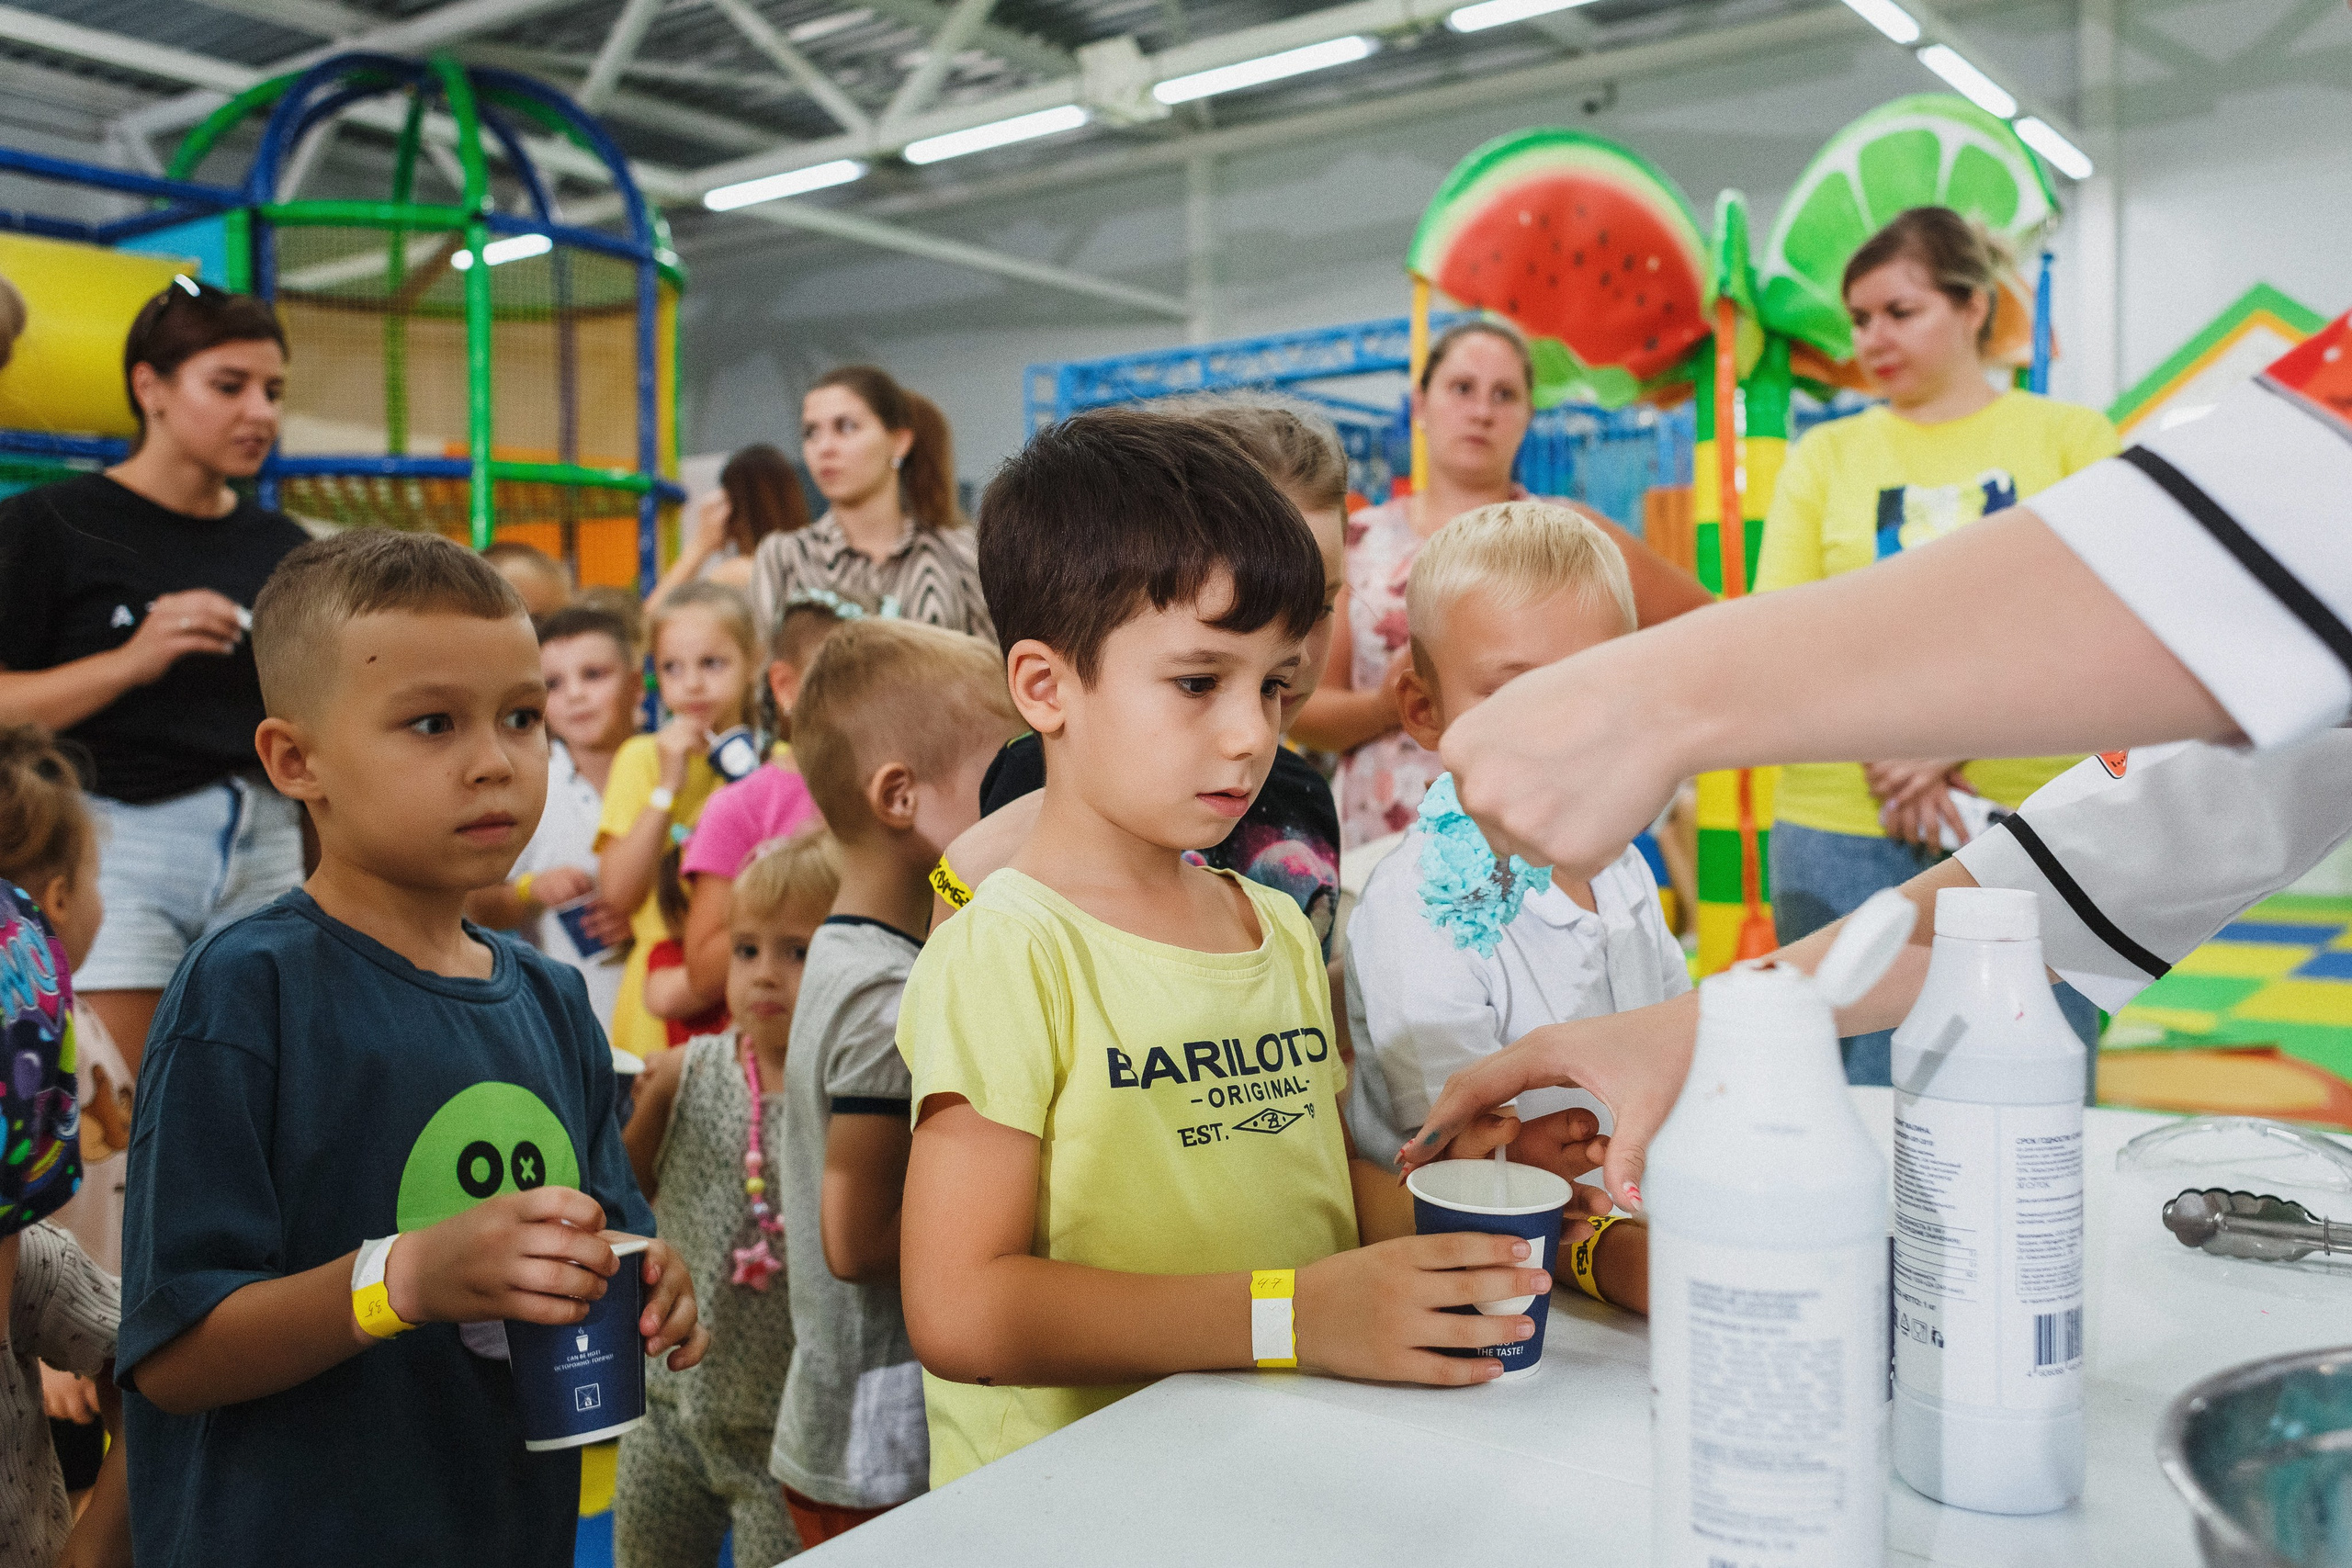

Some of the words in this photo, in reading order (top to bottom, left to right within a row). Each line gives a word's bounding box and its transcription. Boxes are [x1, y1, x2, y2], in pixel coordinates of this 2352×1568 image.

[1177, 1122, 1230, 1147] EST.
[1477, 1348, 1494, 1357] THE
[1497, 1346, 1524, 1357] TASTE!
